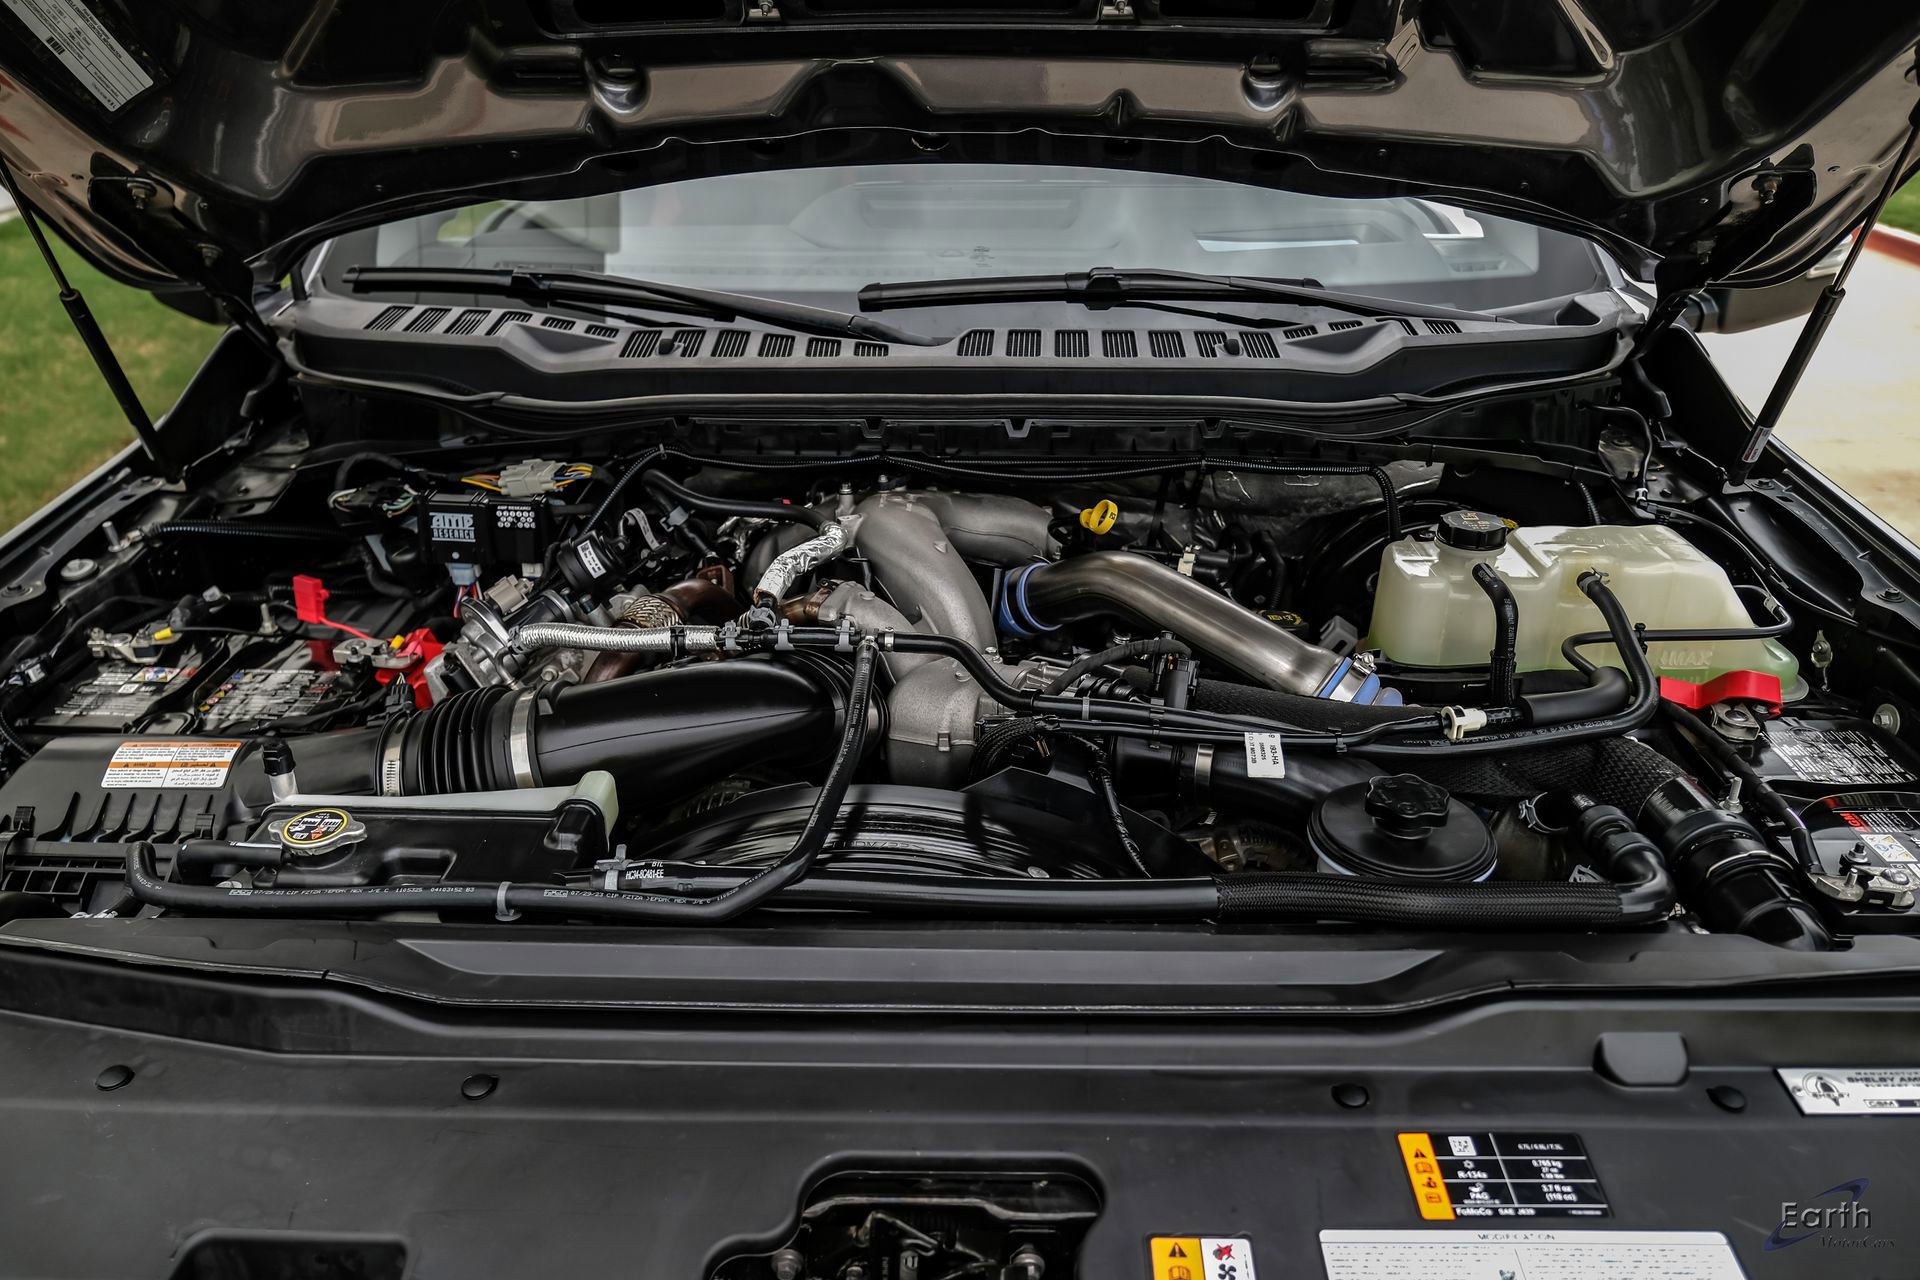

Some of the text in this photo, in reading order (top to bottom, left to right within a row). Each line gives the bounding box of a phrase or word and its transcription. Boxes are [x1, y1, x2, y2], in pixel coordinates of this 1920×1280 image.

[431, 513, 474, 528] AMP
[433, 529, 475, 540] RESEARCH
[1457, 1170, 1488, 1179] R-134a
[1456, 1207, 1494, 1216] FoMoCo
